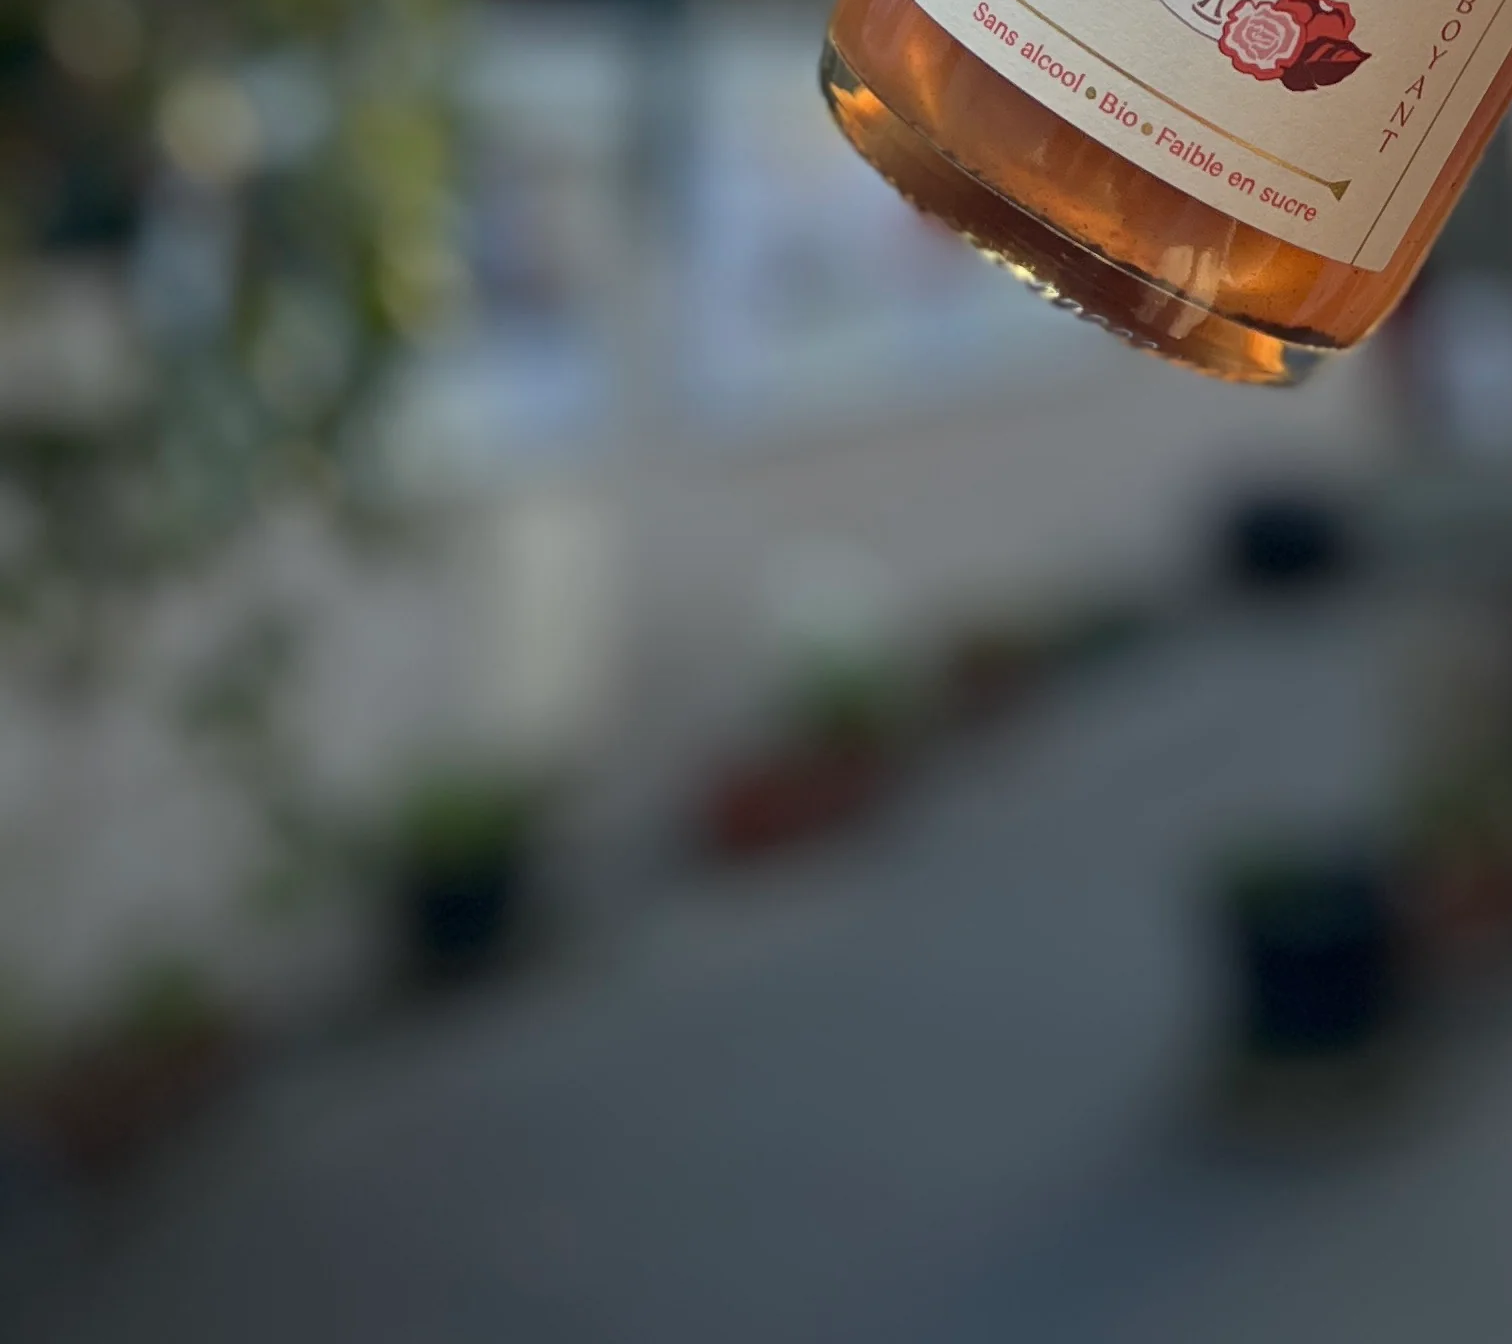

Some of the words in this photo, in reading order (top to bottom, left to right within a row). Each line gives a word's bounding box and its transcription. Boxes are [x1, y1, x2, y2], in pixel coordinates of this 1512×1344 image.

[972, 1, 1019, 47] Sans
[1020, 41, 1086, 93] alcool
[1098, 91, 1139, 128] Bio
[1155, 126, 1223, 178] Faible
[1228, 171, 1255, 196] en
[1259, 185, 1318, 222] sucre
